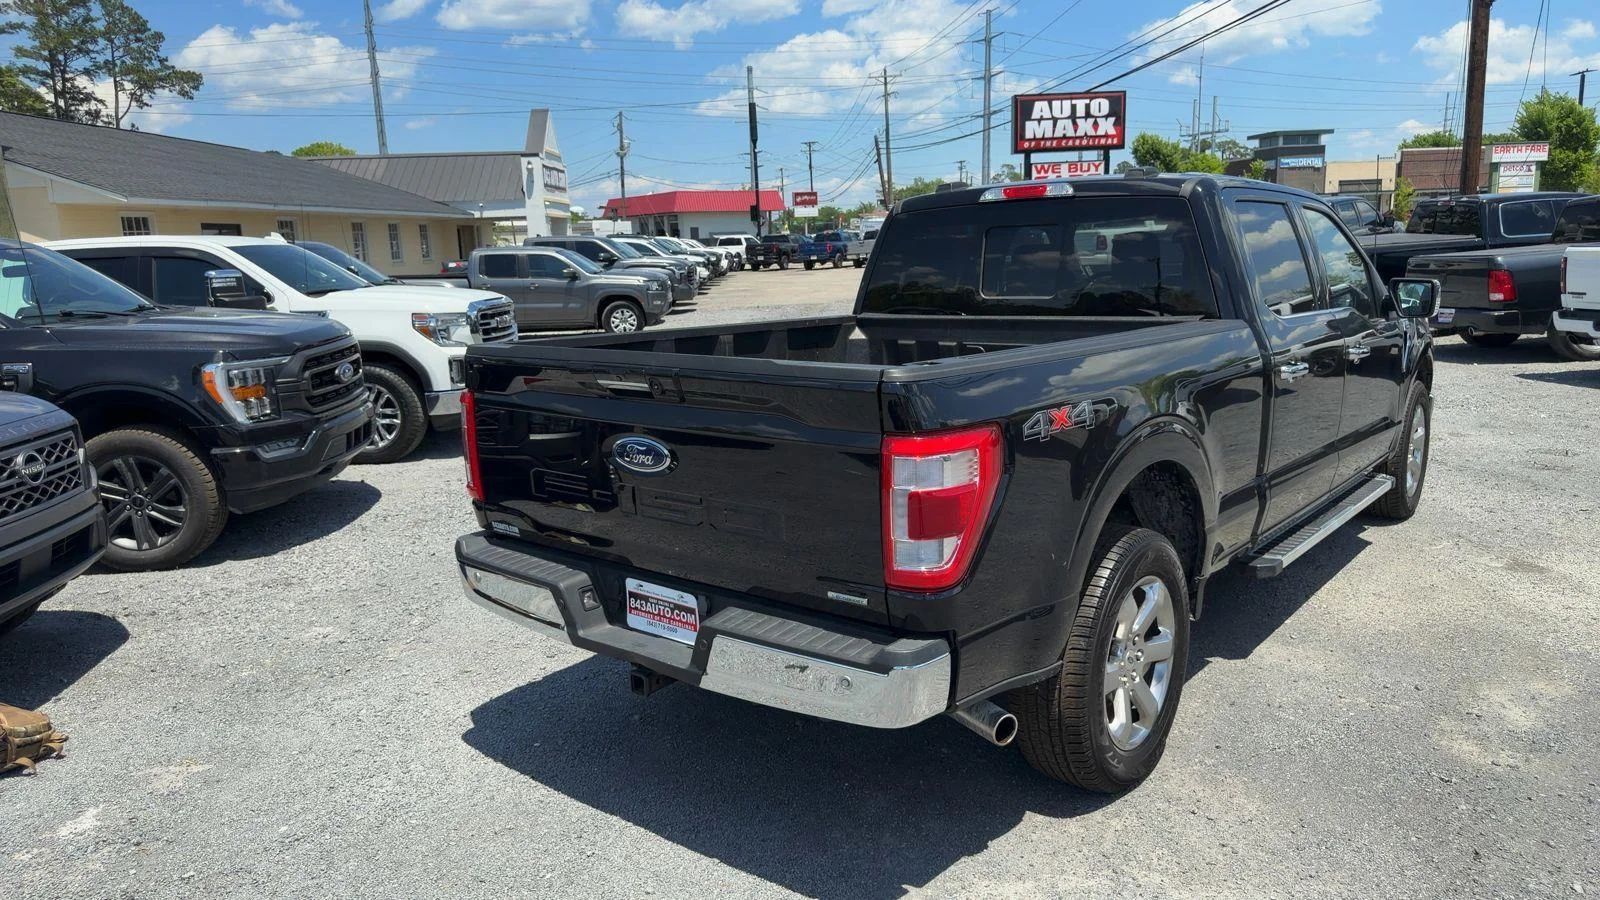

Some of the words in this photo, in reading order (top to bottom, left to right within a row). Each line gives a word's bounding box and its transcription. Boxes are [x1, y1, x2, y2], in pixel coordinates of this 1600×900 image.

[1031, 98, 1110, 119] AUTO
[1025, 117, 1116, 139] MAXX
[1024, 141, 1036, 149] OF
[1040, 140, 1056, 148] THE
[1062, 138, 1118, 147] CAROLINAS
[1494, 145, 1523, 154] EARTH
[1524, 144, 1547, 153] FARE
[1034, 164, 1061, 174] WE
[1068, 162, 1103, 173] BUY
[1299, 157, 1321, 168] DENTAL
[624, 444, 654, 465] Ford
[630, 597, 696, 625] 843AUTO.COM
